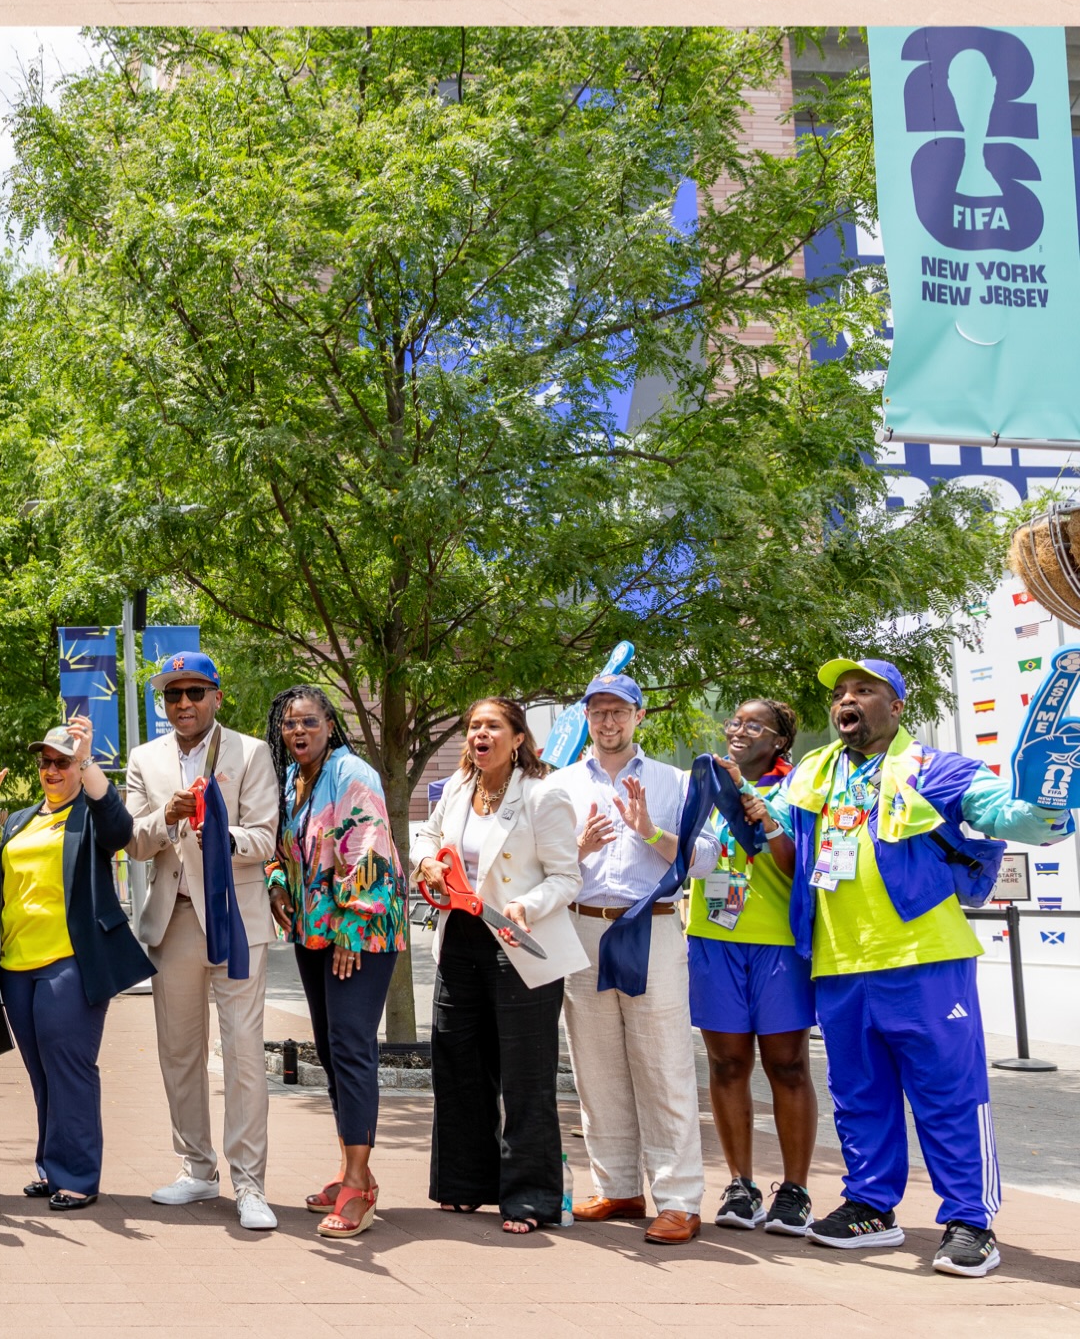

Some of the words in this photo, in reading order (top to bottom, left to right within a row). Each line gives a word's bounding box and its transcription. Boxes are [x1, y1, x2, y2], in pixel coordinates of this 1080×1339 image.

[953, 204, 1011, 231] FIFA
[921, 256, 969, 282] NEW
[975, 261, 1047, 284] YORK
[922, 281, 971, 306] NEW
[979, 285, 1049, 308] JERSEY
[1046, 678, 1069, 706] ASK
[1034, 711, 1055, 734] ME
